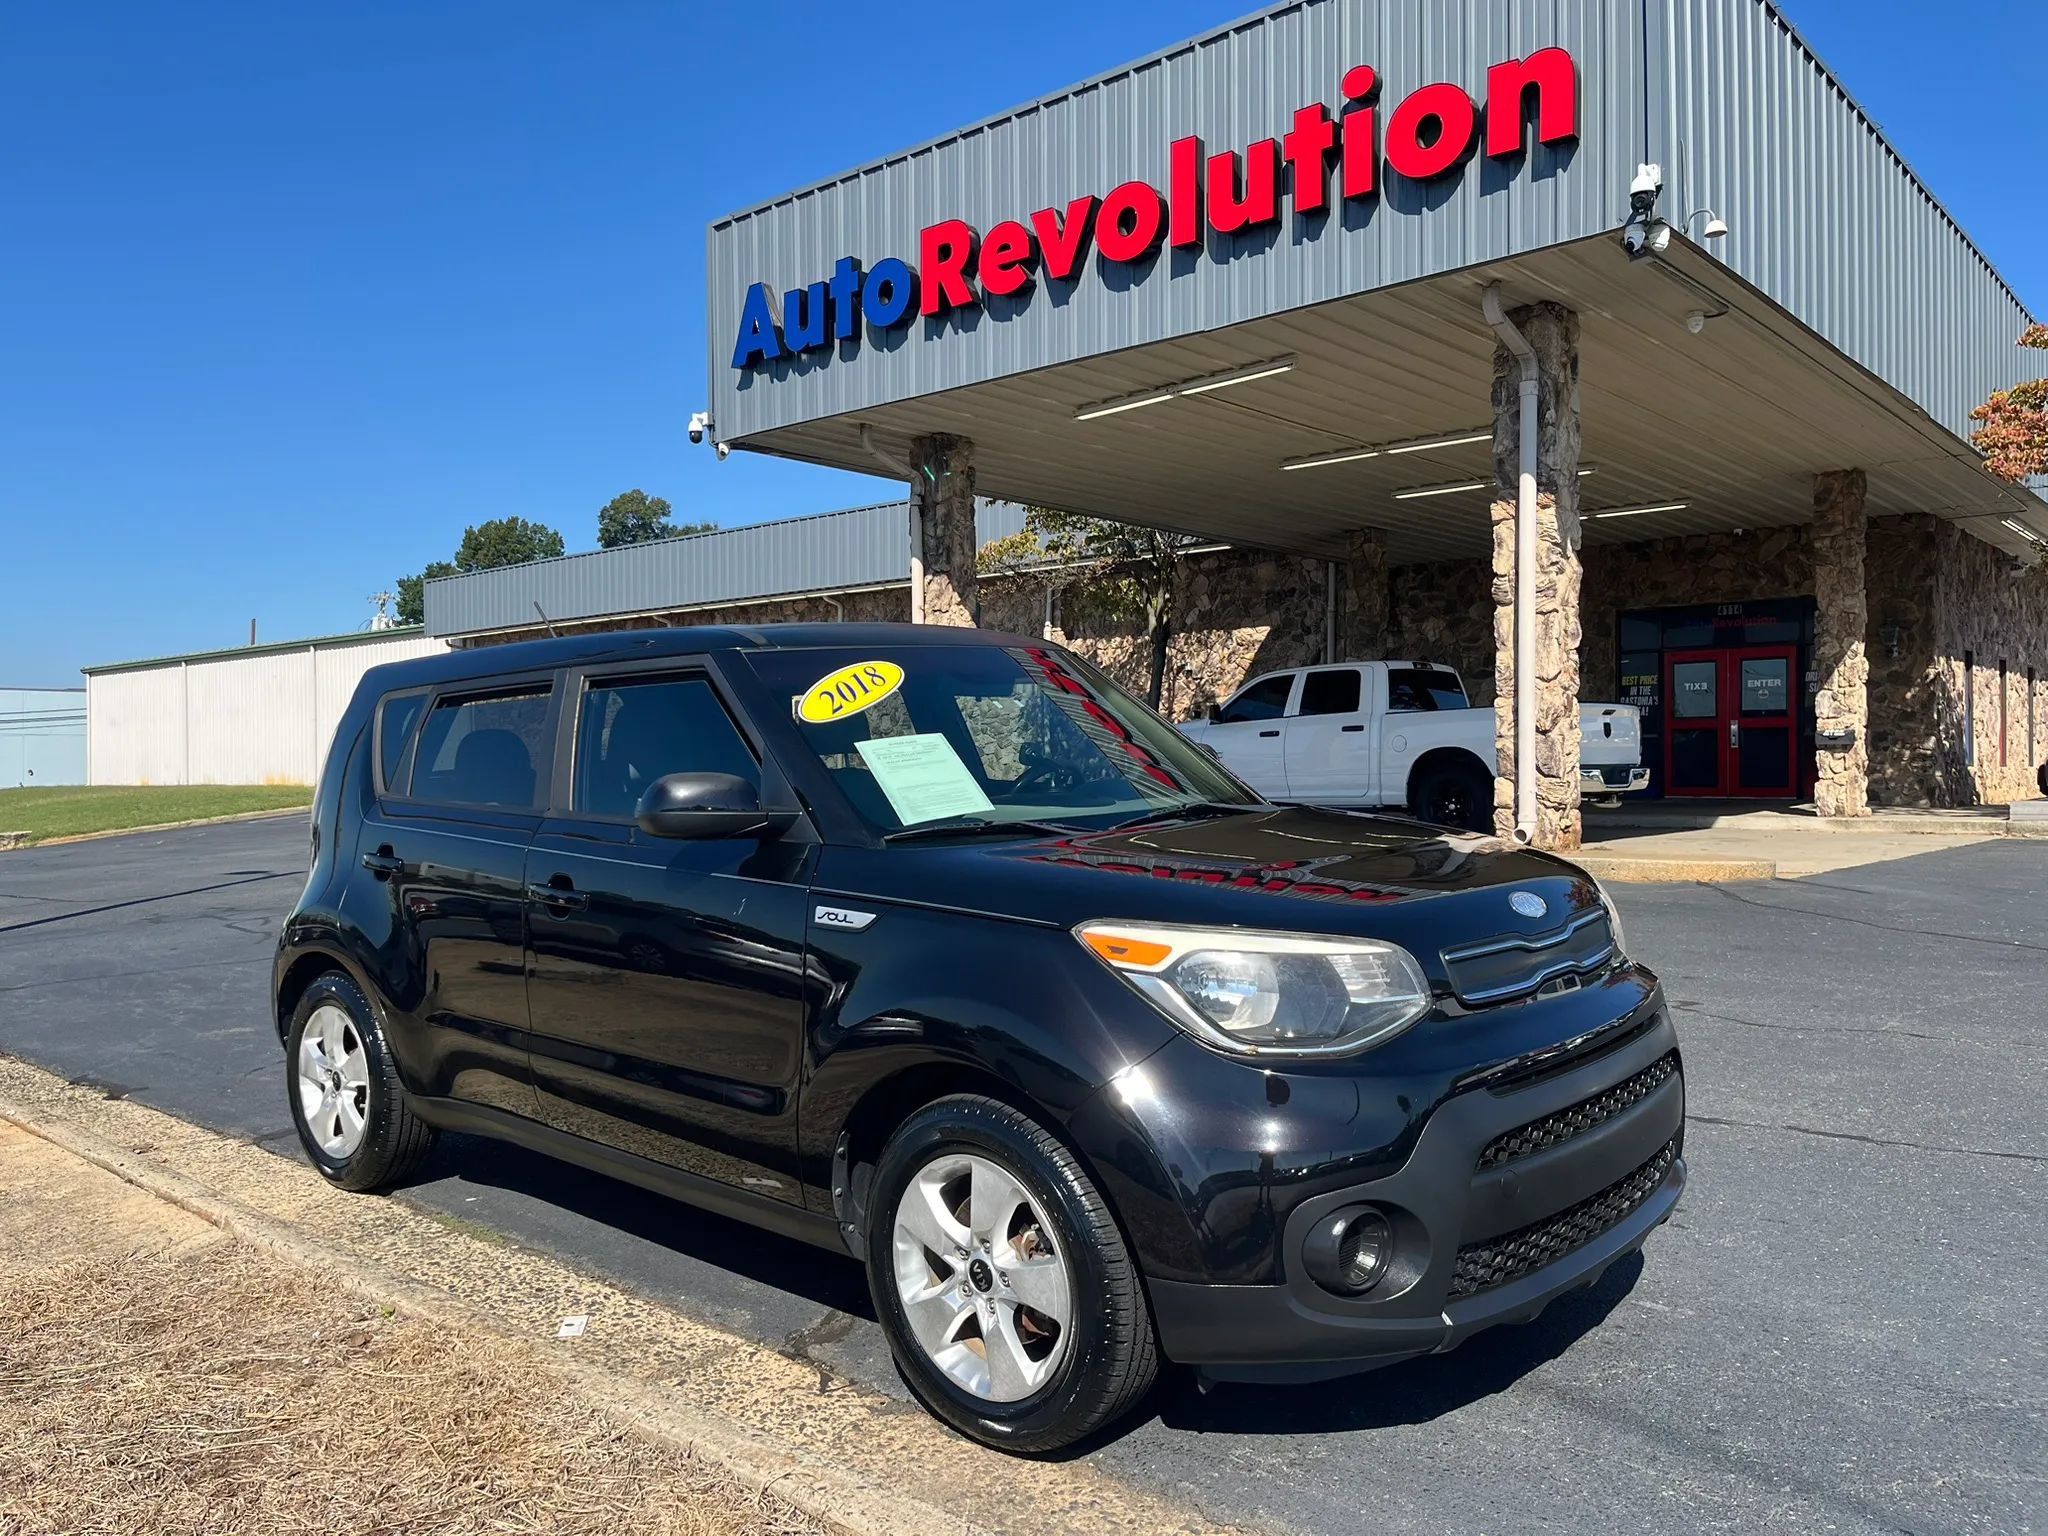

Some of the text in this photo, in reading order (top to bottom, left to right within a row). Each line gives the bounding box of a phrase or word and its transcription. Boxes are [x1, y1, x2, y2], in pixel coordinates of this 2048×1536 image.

[1621, 674, 1659, 686] BEST PRICE
[1747, 678, 1782, 688] ENTER
[819, 665, 887, 715] 2018
[1629, 685, 1652, 696] IN THE
